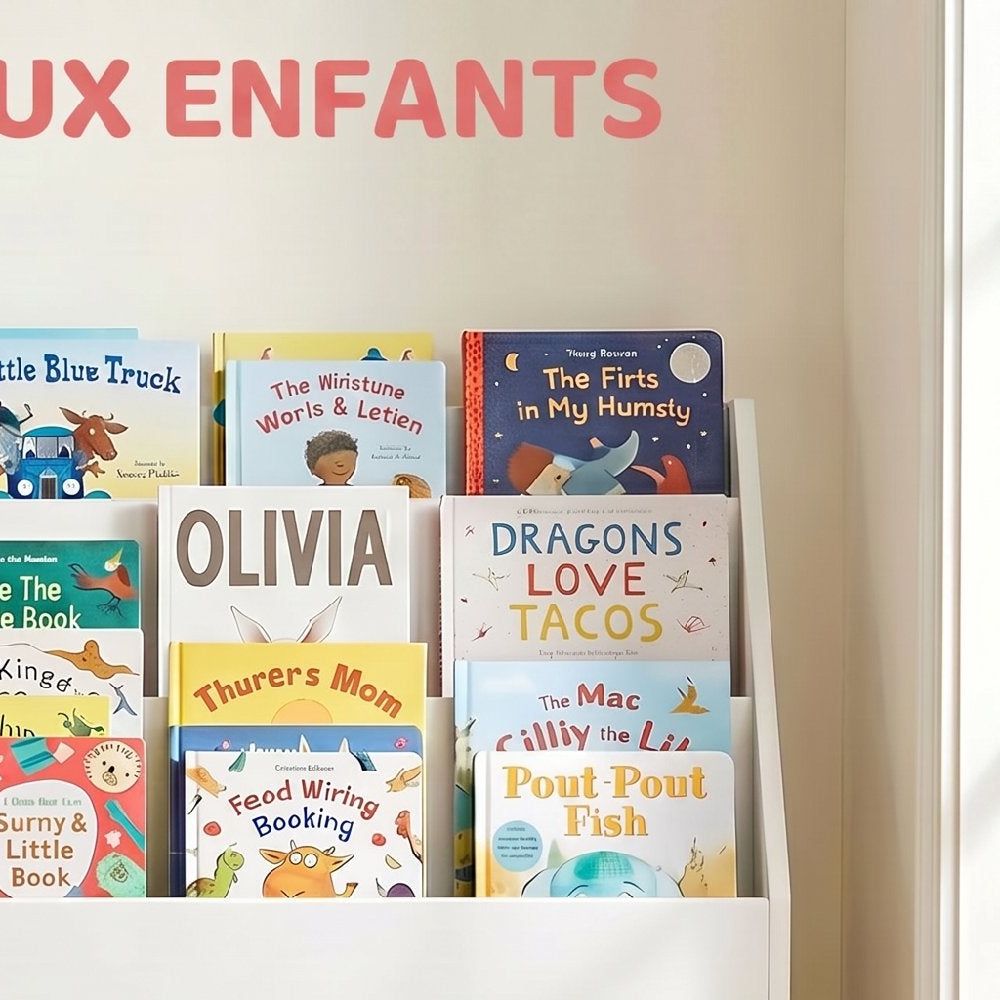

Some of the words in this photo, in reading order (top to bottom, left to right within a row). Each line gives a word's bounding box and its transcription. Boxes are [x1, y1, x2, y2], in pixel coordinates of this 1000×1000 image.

[44, 353, 99, 383] Blue
[105, 354, 182, 394] Truck
[543, 367, 590, 390] The
[601, 366, 659, 389] Firts
[270, 380, 310, 401] The
[255, 400, 324, 434] Worls
[333, 396, 348, 416] &
[358, 400, 424, 435] Letien
[517, 400, 539, 421] in
[548, 396, 588, 425] My
[598, 396, 691, 427] Humsty
[176, 509, 393, 587] OLIVIA
[491, 521, 682, 556] DRAGONS
[20, 576, 62, 602] The
[527, 562, 646, 597] LOVE
[22, 604, 82, 629] Book
[509, 603, 663, 643] TACOS
[330, 663, 402, 719] Mom
[538, 695, 570, 711] The
[577, 683, 641, 711] Mac
[600, 726, 630, 743] the
[228, 779, 292, 816] Feod
[302, 778, 380, 820] Wiring
[71, 812, 88, 833] &
[252, 806, 355, 843] Booking
[563, 804, 649, 838] Fish
[6, 838, 74, 860] Little
[11, 867, 71, 887] Book
